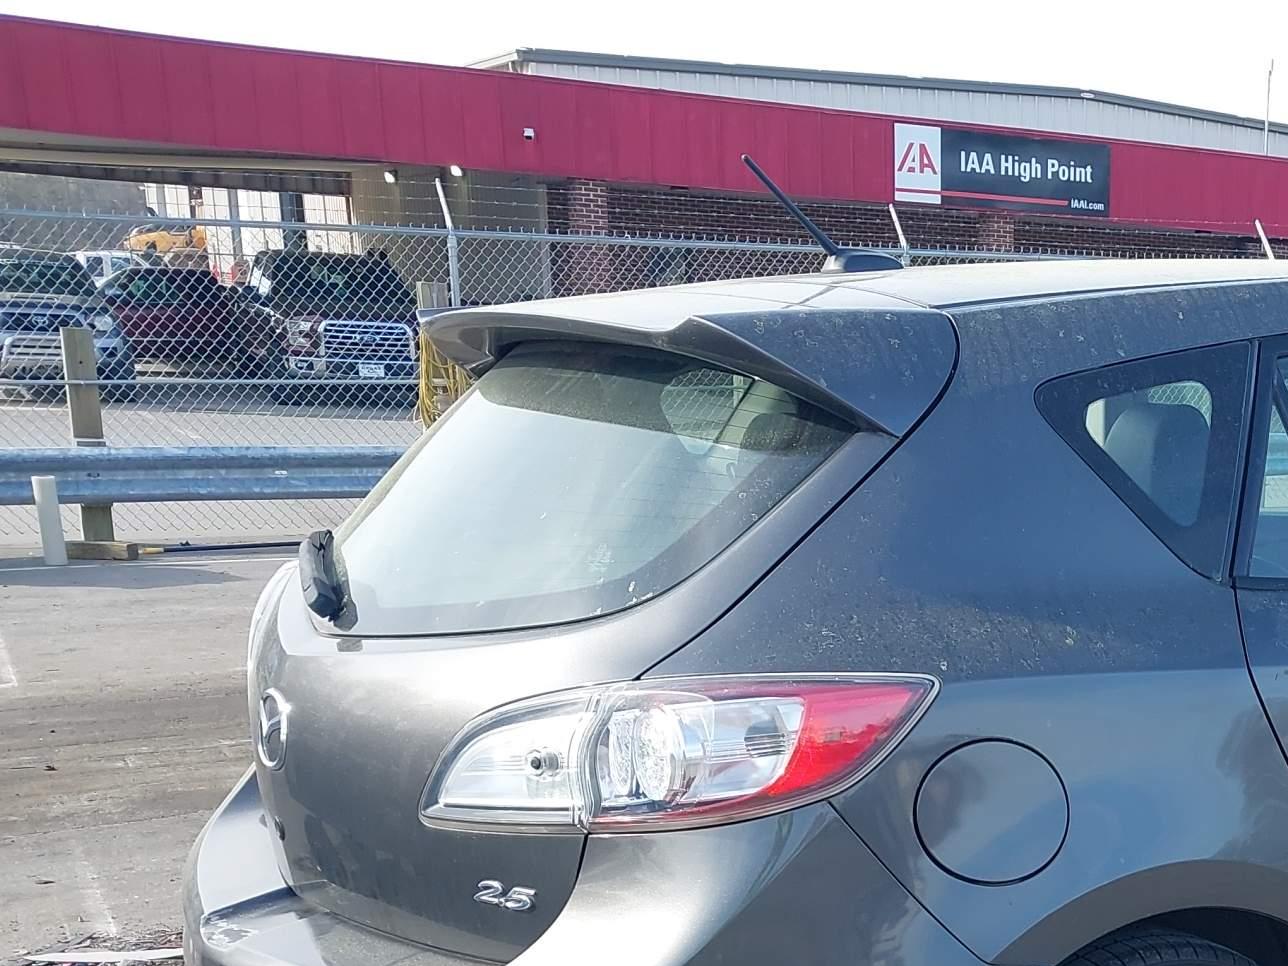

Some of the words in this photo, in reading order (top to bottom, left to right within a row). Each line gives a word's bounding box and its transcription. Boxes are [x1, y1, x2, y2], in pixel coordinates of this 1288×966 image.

[960, 150, 995, 174] IAA
[1000, 154, 1041, 183] High
[1047, 158, 1093, 183] Point
[473, 880, 537, 911] 2.5
